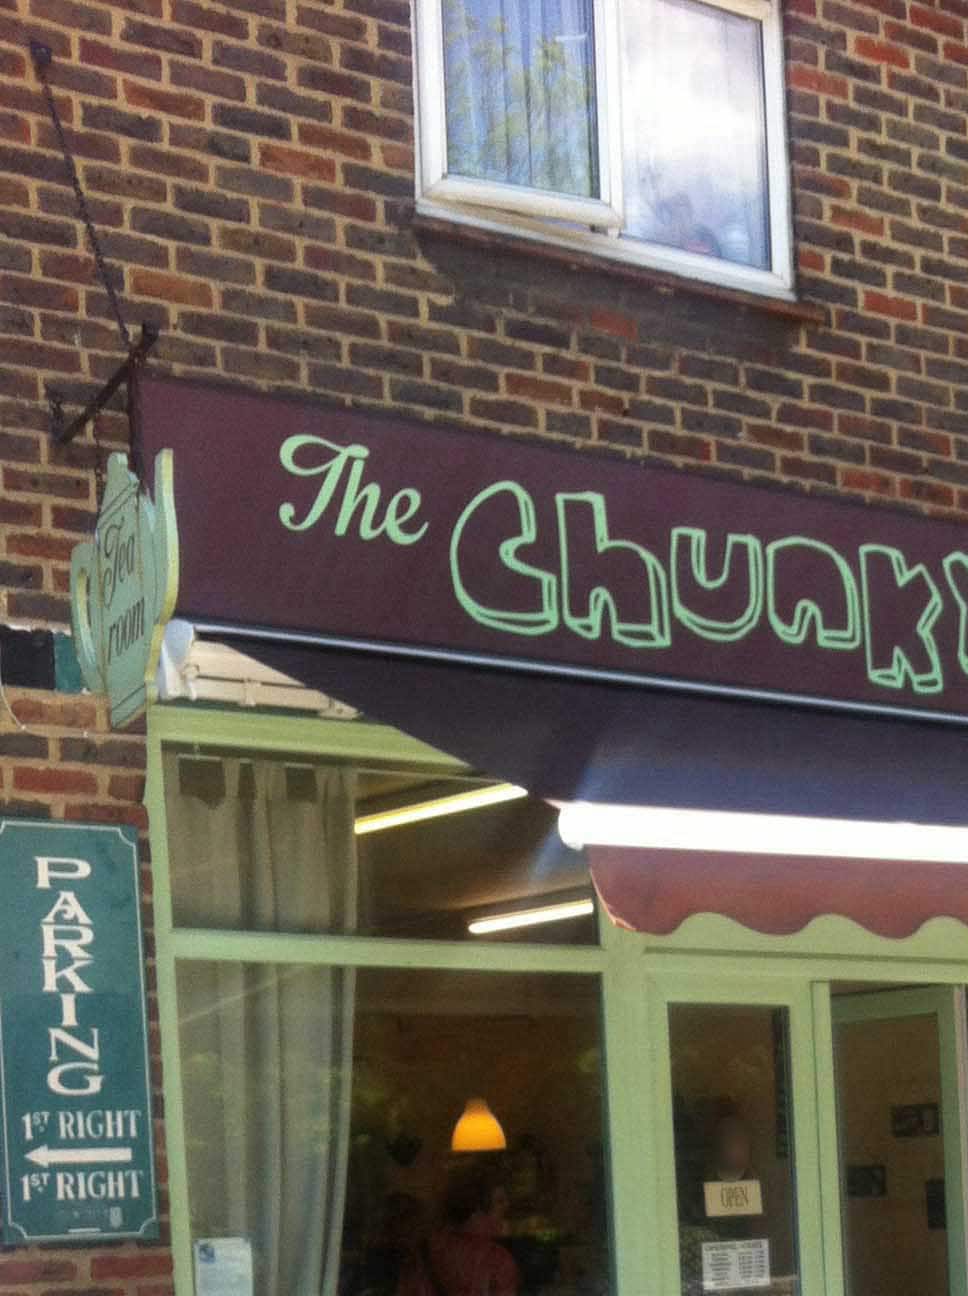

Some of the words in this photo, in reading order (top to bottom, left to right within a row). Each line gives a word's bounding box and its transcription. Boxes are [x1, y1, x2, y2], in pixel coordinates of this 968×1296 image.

[279, 434, 428, 545] The
[103, 516, 135, 610] Tea
[107, 597, 144, 663] room
[34, 856, 104, 1096] PARKING
[58, 1110, 142, 1140] RIGHT
[56, 1169, 144, 1200] RIGHT
